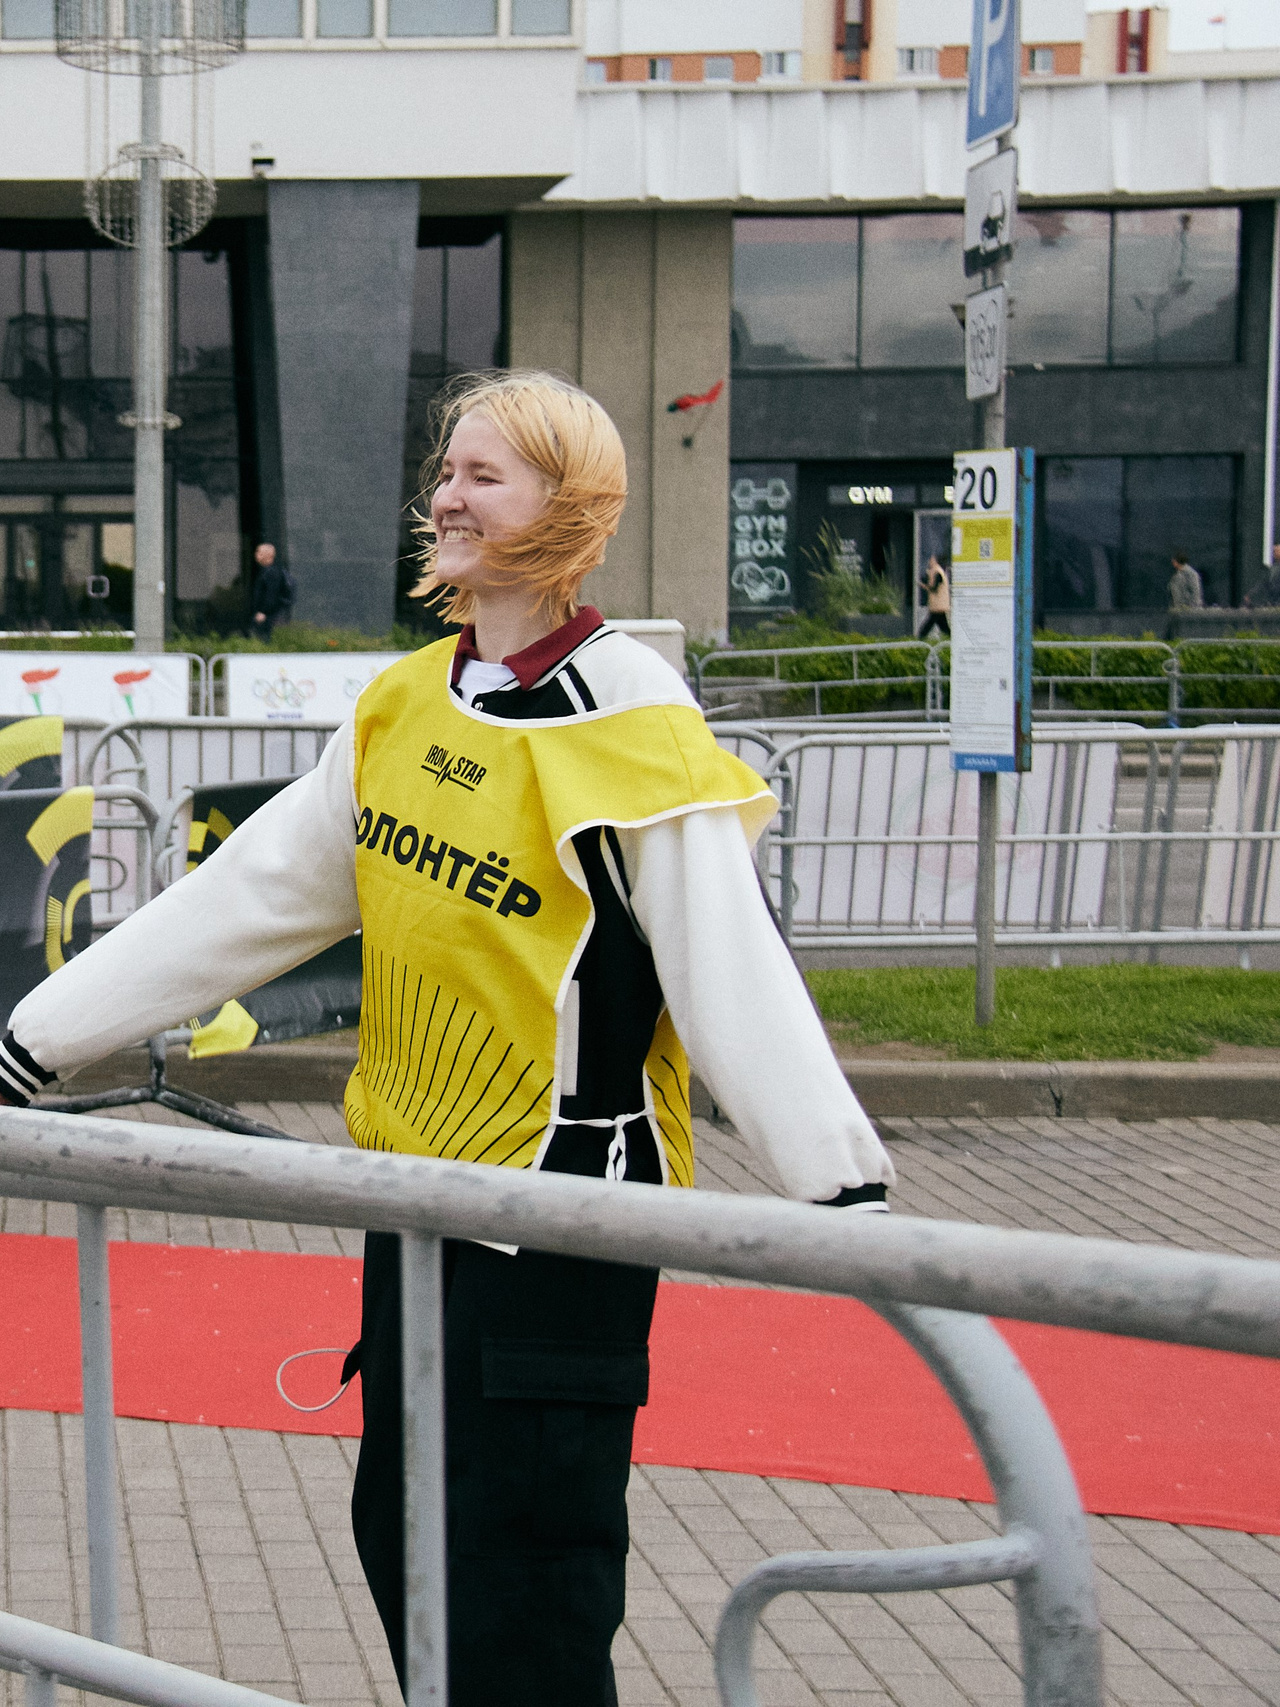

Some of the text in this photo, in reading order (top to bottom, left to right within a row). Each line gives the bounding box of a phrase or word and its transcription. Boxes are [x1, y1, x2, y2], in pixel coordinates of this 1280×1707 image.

[848, 486, 893, 504] GYM
[960, 466, 997, 510] 20
[734, 515, 788, 536] GYM
[734, 538, 787, 558] BOX
[424, 743, 487, 786] IRON STAR
